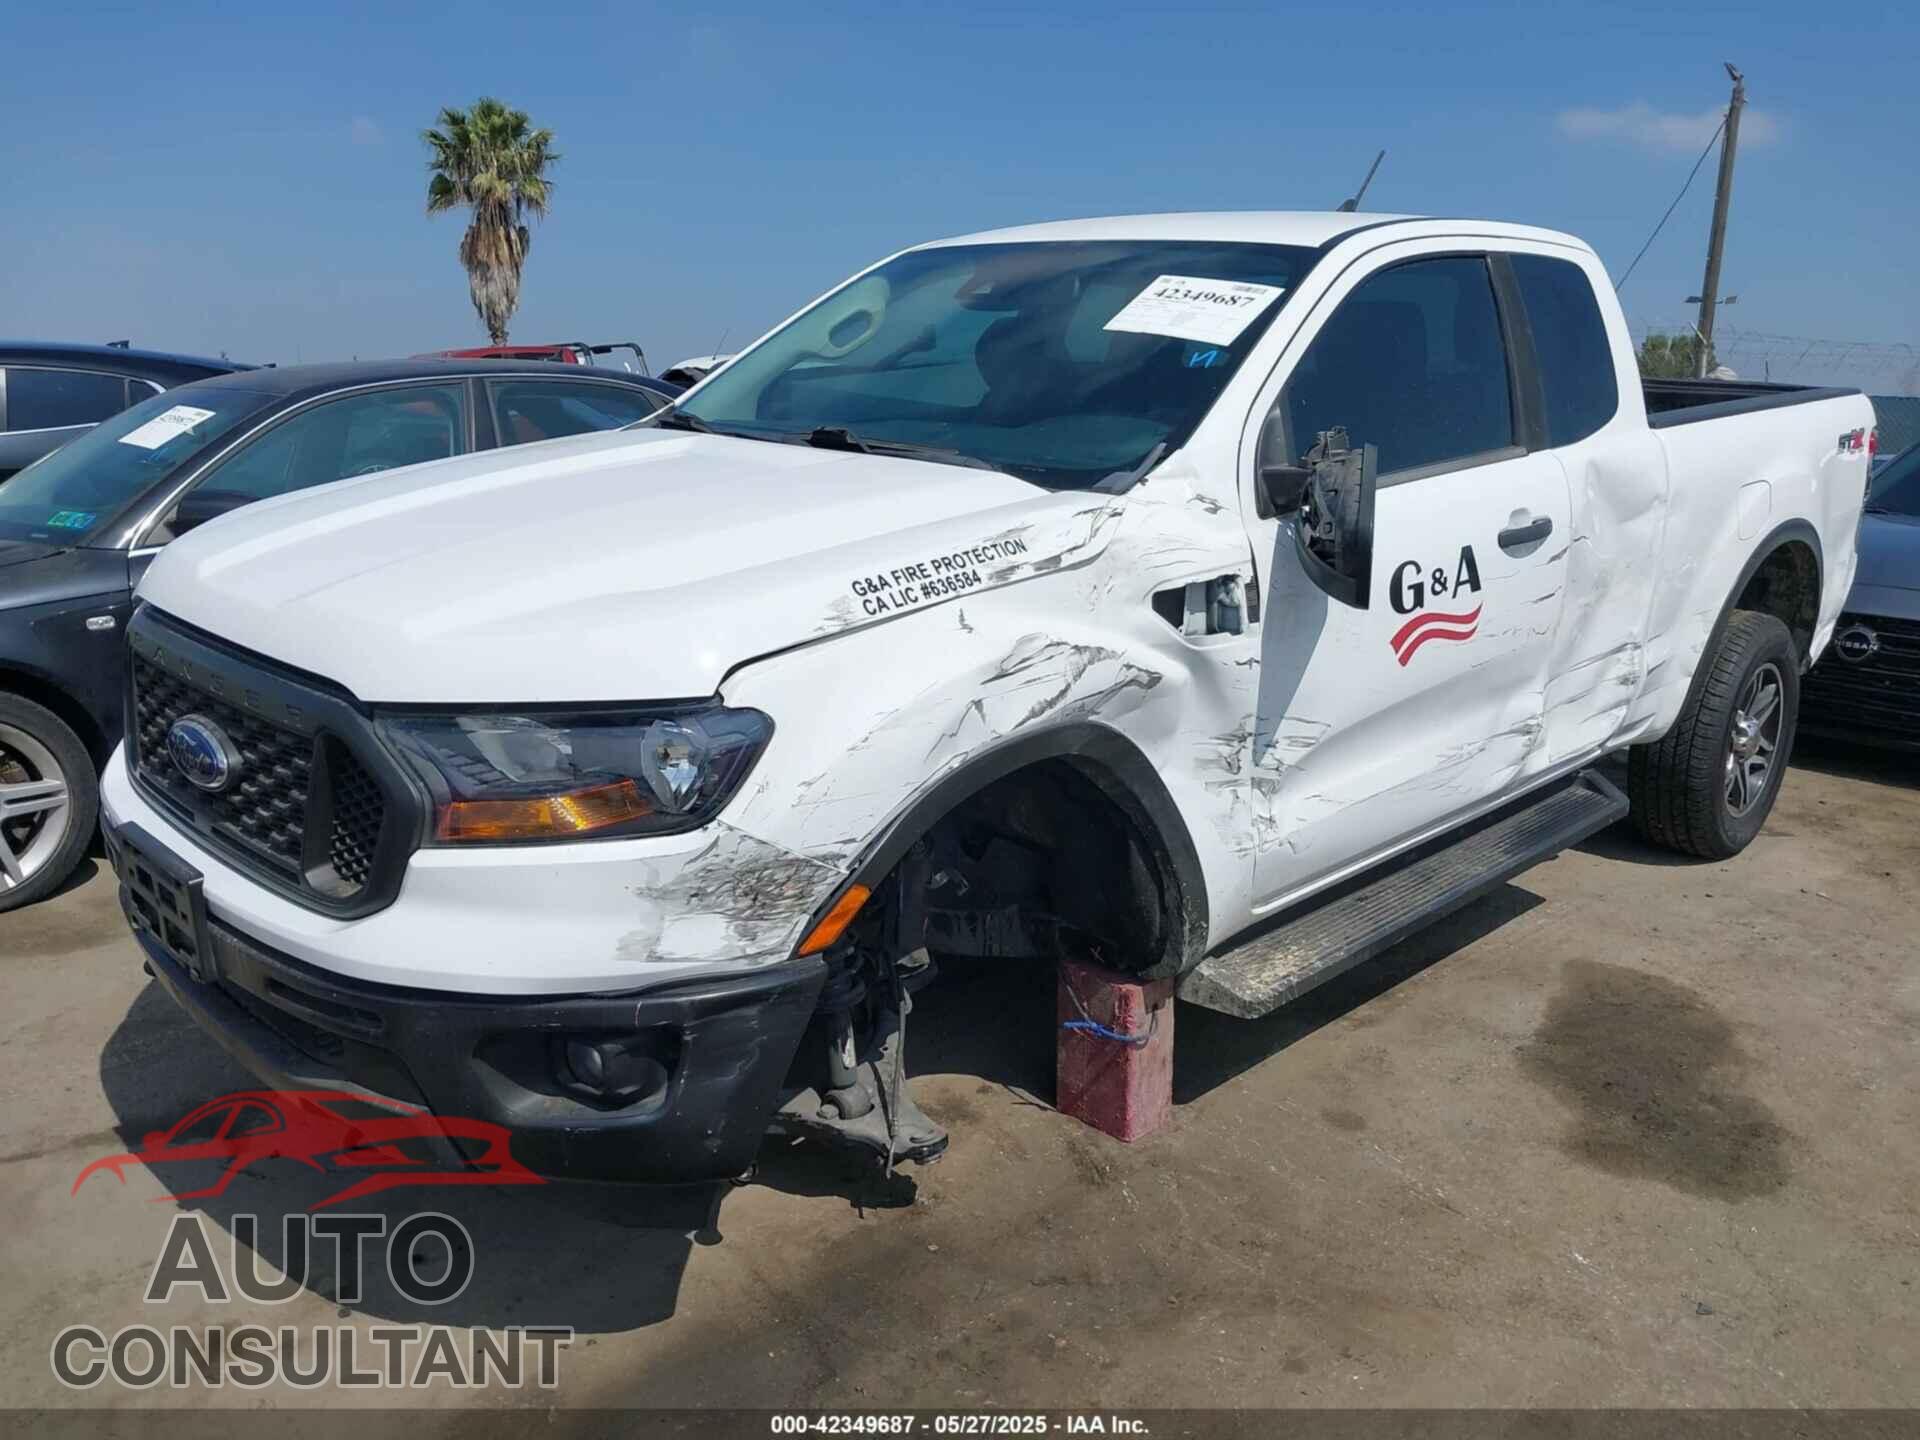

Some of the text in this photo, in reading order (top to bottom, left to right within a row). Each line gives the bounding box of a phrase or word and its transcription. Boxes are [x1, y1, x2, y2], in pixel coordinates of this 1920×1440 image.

[1154, 287, 1256, 308] 42349687
[851, 538, 1029, 597] G&A FIRE PROTECTION
[862, 569, 982, 616] CA LIC #636584
